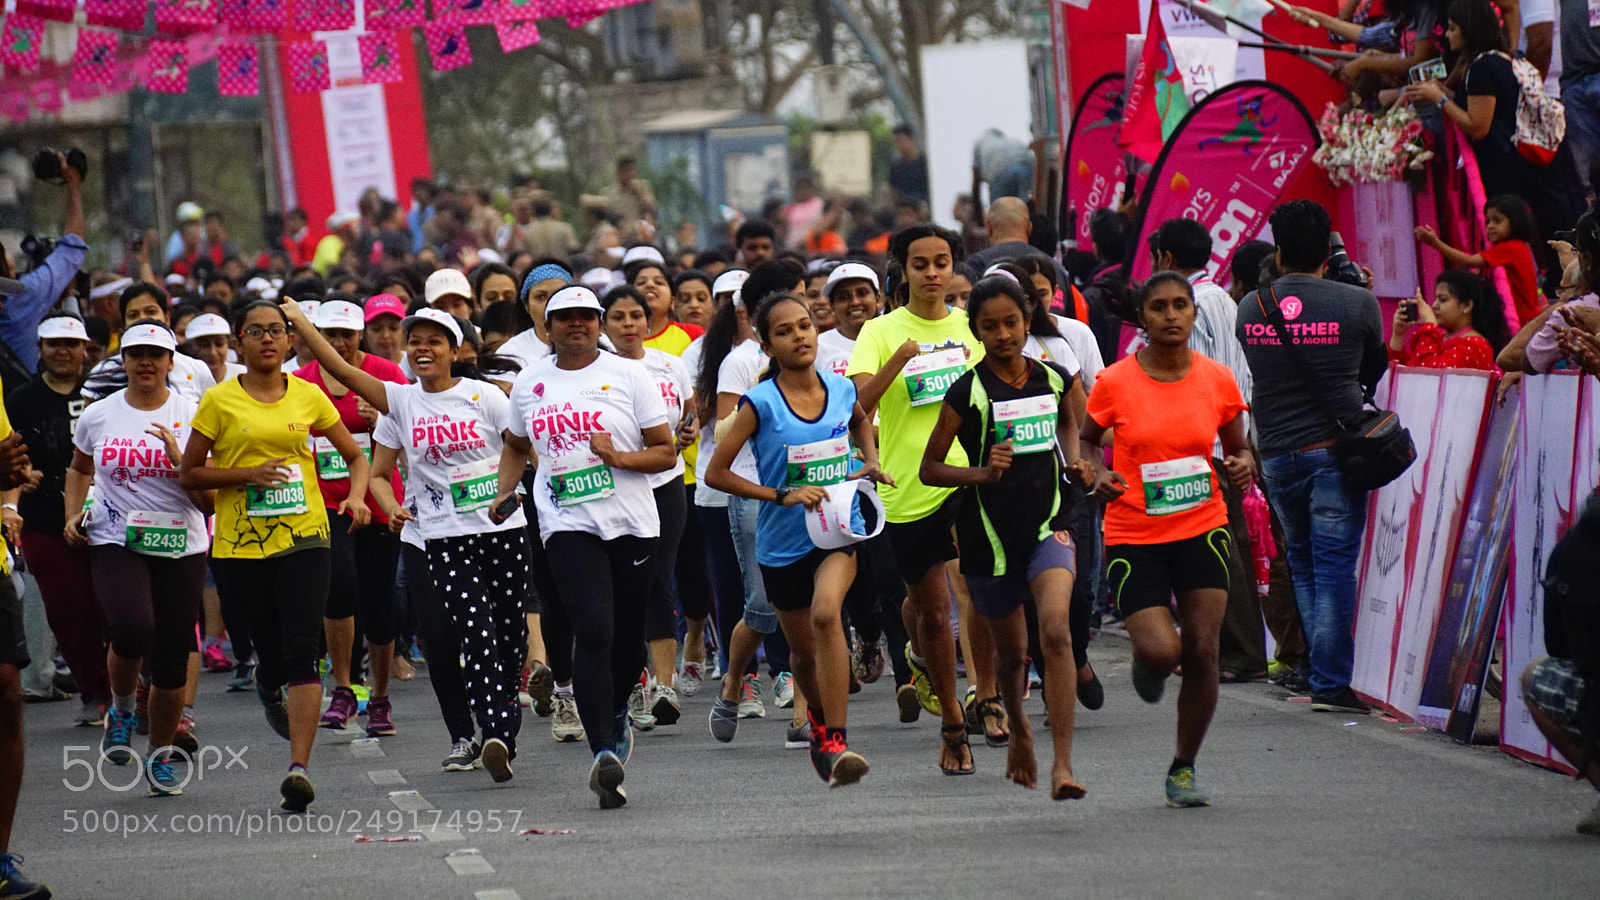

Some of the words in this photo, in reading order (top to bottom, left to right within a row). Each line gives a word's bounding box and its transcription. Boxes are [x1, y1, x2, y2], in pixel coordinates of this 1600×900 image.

[1273, 144, 1308, 189] BAJAJ
[1183, 188, 1212, 221] ors
[1260, 338, 1282, 346] WILL
[1292, 337, 1301, 346] O
[925, 371, 966, 392] 5010
[417, 415, 438, 426] AM
[442, 414, 451, 423] A
[537, 404, 558, 417] AM
[563, 402, 573, 412] A
[412, 420, 481, 448] PINK
[532, 411, 605, 440] PINK
[1015, 419, 1056, 441] 50101
[110, 438, 132, 447] AM
[137, 439, 147, 447] A
[448, 439, 486, 452] SISTER
[101, 447, 175, 469] PINK
[137, 468, 180, 479] SISTER
[566, 470, 611, 494] 50103
[807, 460, 848, 483] 50040
[265, 487, 304, 505] 50038
[468, 479, 498, 499] 5005
[1165, 478, 1210, 501] 50096
[143, 532, 185, 548] 52433
